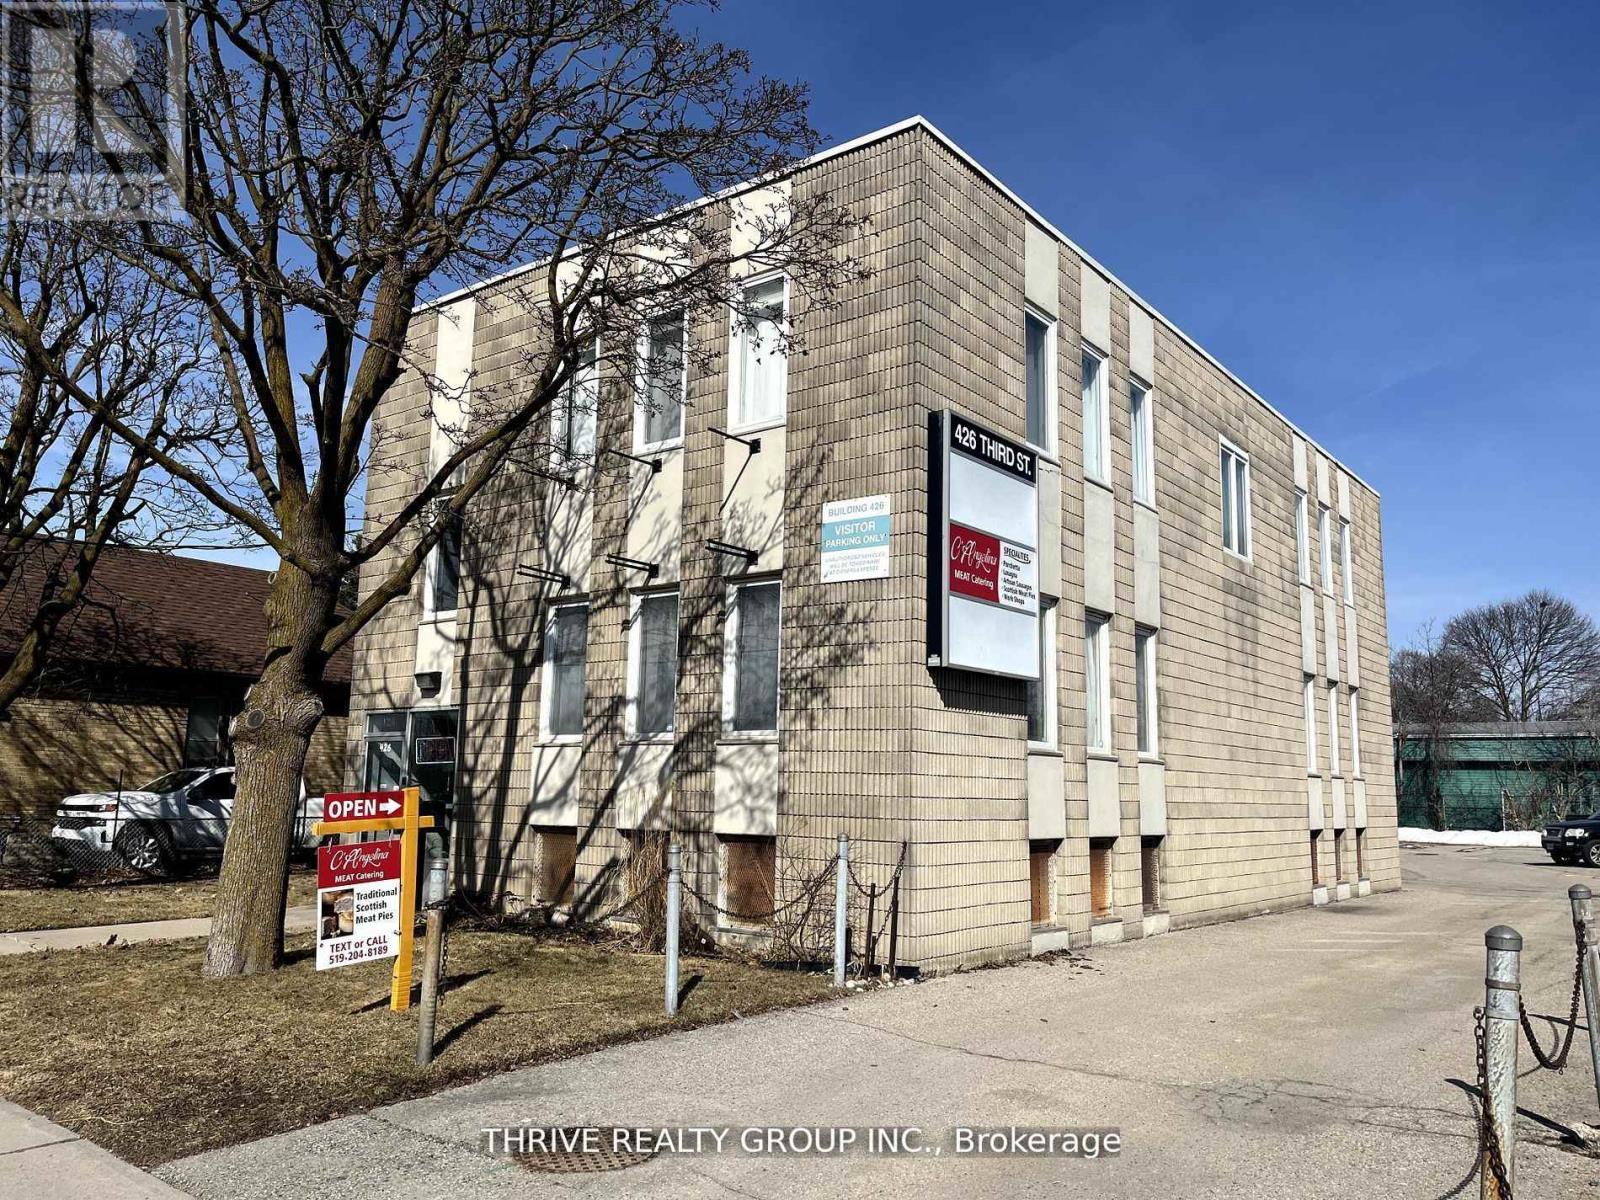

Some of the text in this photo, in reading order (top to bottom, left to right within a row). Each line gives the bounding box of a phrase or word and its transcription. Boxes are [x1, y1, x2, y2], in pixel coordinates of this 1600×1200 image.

[954, 423, 1032, 476] 426 THIRD ST.
[828, 503, 868, 517] BUILDING
[834, 520, 876, 536] VISITOR
[825, 533, 885, 548] PARKING ONLY
[954, 568, 994, 591] MEAT Catering
[328, 798, 378, 819] OPEN
[334, 870, 384, 883] MEAT Catering
[356, 887, 398, 901] Traditional
[356, 900, 387, 913] Scottish
[355, 911, 394, 925] Meat Pies
[329, 935, 388, 954] TEXT or CALL
